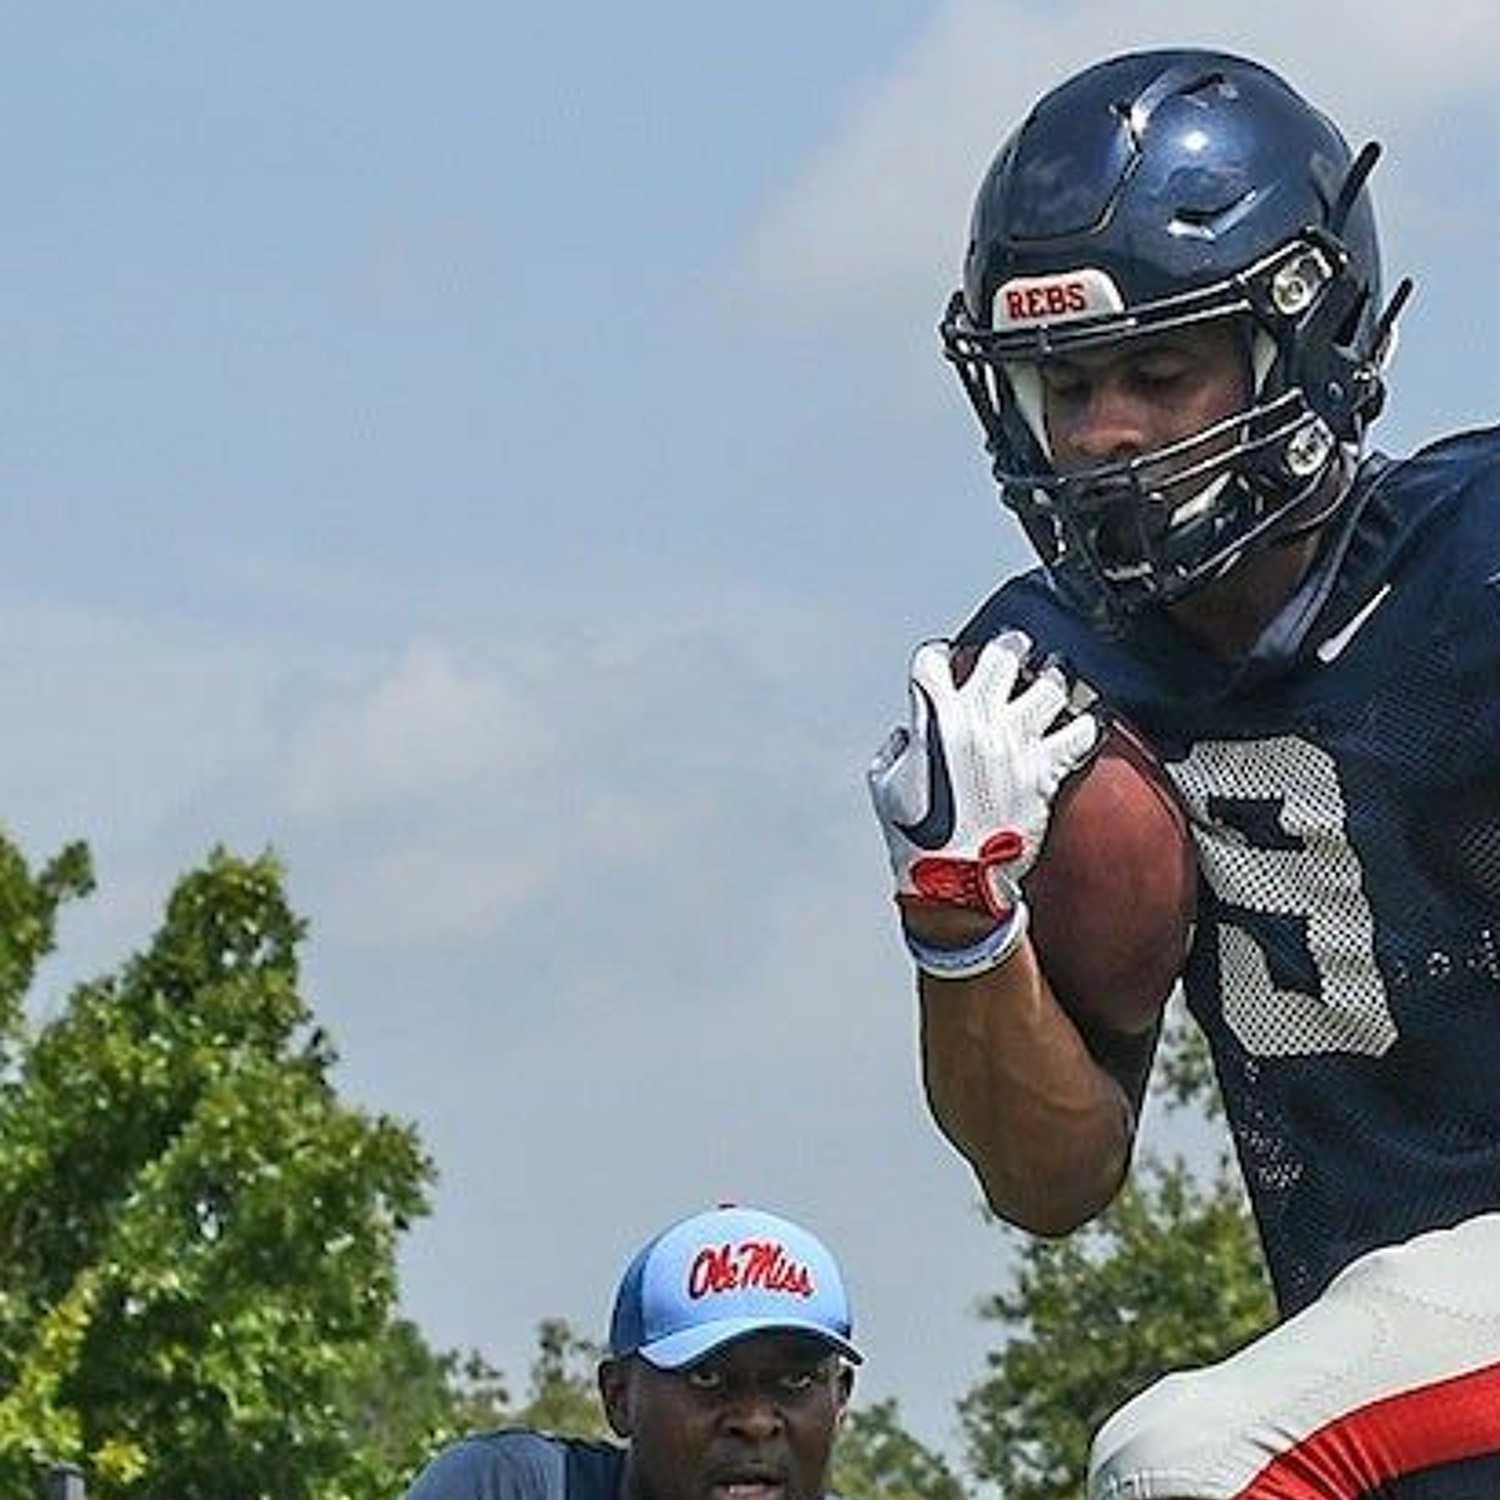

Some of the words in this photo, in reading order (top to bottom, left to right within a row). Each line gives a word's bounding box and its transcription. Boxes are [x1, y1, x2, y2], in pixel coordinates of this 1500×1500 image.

[1006, 282, 1086, 320] REBS
[688, 1243, 740, 1300] Ole
[738, 1242, 814, 1298] Miss
